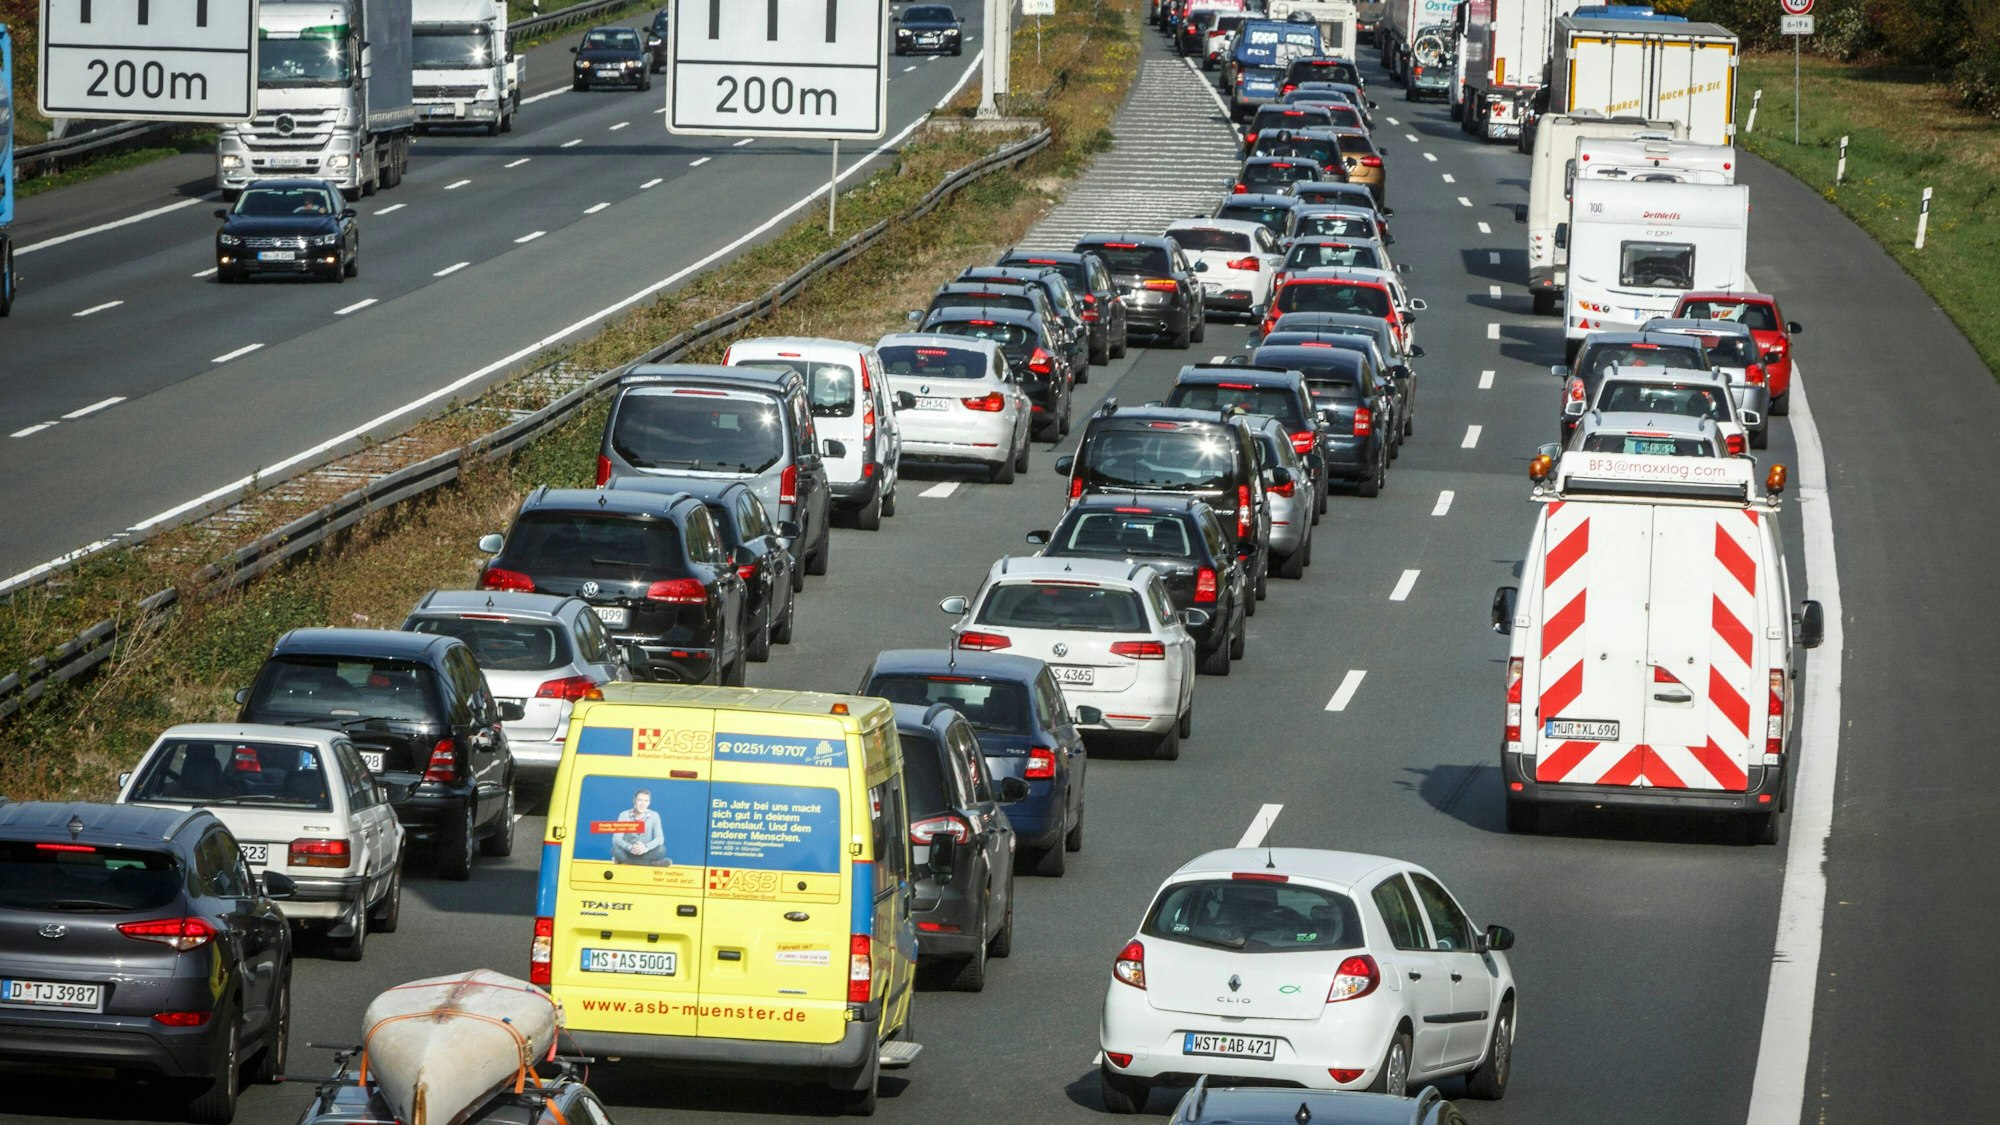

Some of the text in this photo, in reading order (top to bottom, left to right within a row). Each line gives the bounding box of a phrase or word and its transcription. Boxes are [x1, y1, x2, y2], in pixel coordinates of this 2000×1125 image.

[87, 58, 207, 100] 200m
[716, 75, 837, 116] 200m
[1659, 89, 1684, 102] AUCH
[1706, 80, 1721, 92] SIE
[1605, 99, 1640, 114] FAHREN
[1589, 202, 1603, 213] 100
[1642, 211, 1681, 220] Dethleffs
[1589, 459, 1726, 480] BF3@maxxlog.com
[1064, 669, 1092, 681] 4365
[1554, 722, 1617, 736] MÜR XL 696
[654, 729, 713, 753] ASB
[733, 742, 808, 757] 0251/19707
[712, 799, 821, 813] Ein Jahr bei uns macht
[712, 810, 800, 822] sich gut in deinem
[711, 820, 812, 833] Lebenslauf. Und dem
[711, 831, 801, 842] anderer Menschen.
[724, 870, 778, 892] ASB
[581, 900, 633, 911] TRANSIT
[591, 952, 673, 971] MS AS 5001
[12, 983, 97, 1002] D TJ 3987
[1217, 996, 1251, 1004] CLIO
[582, 1000, 806, 1022] www.asb-muenster.de
[1194, 1036, 1271, 1055] WST AB 471
